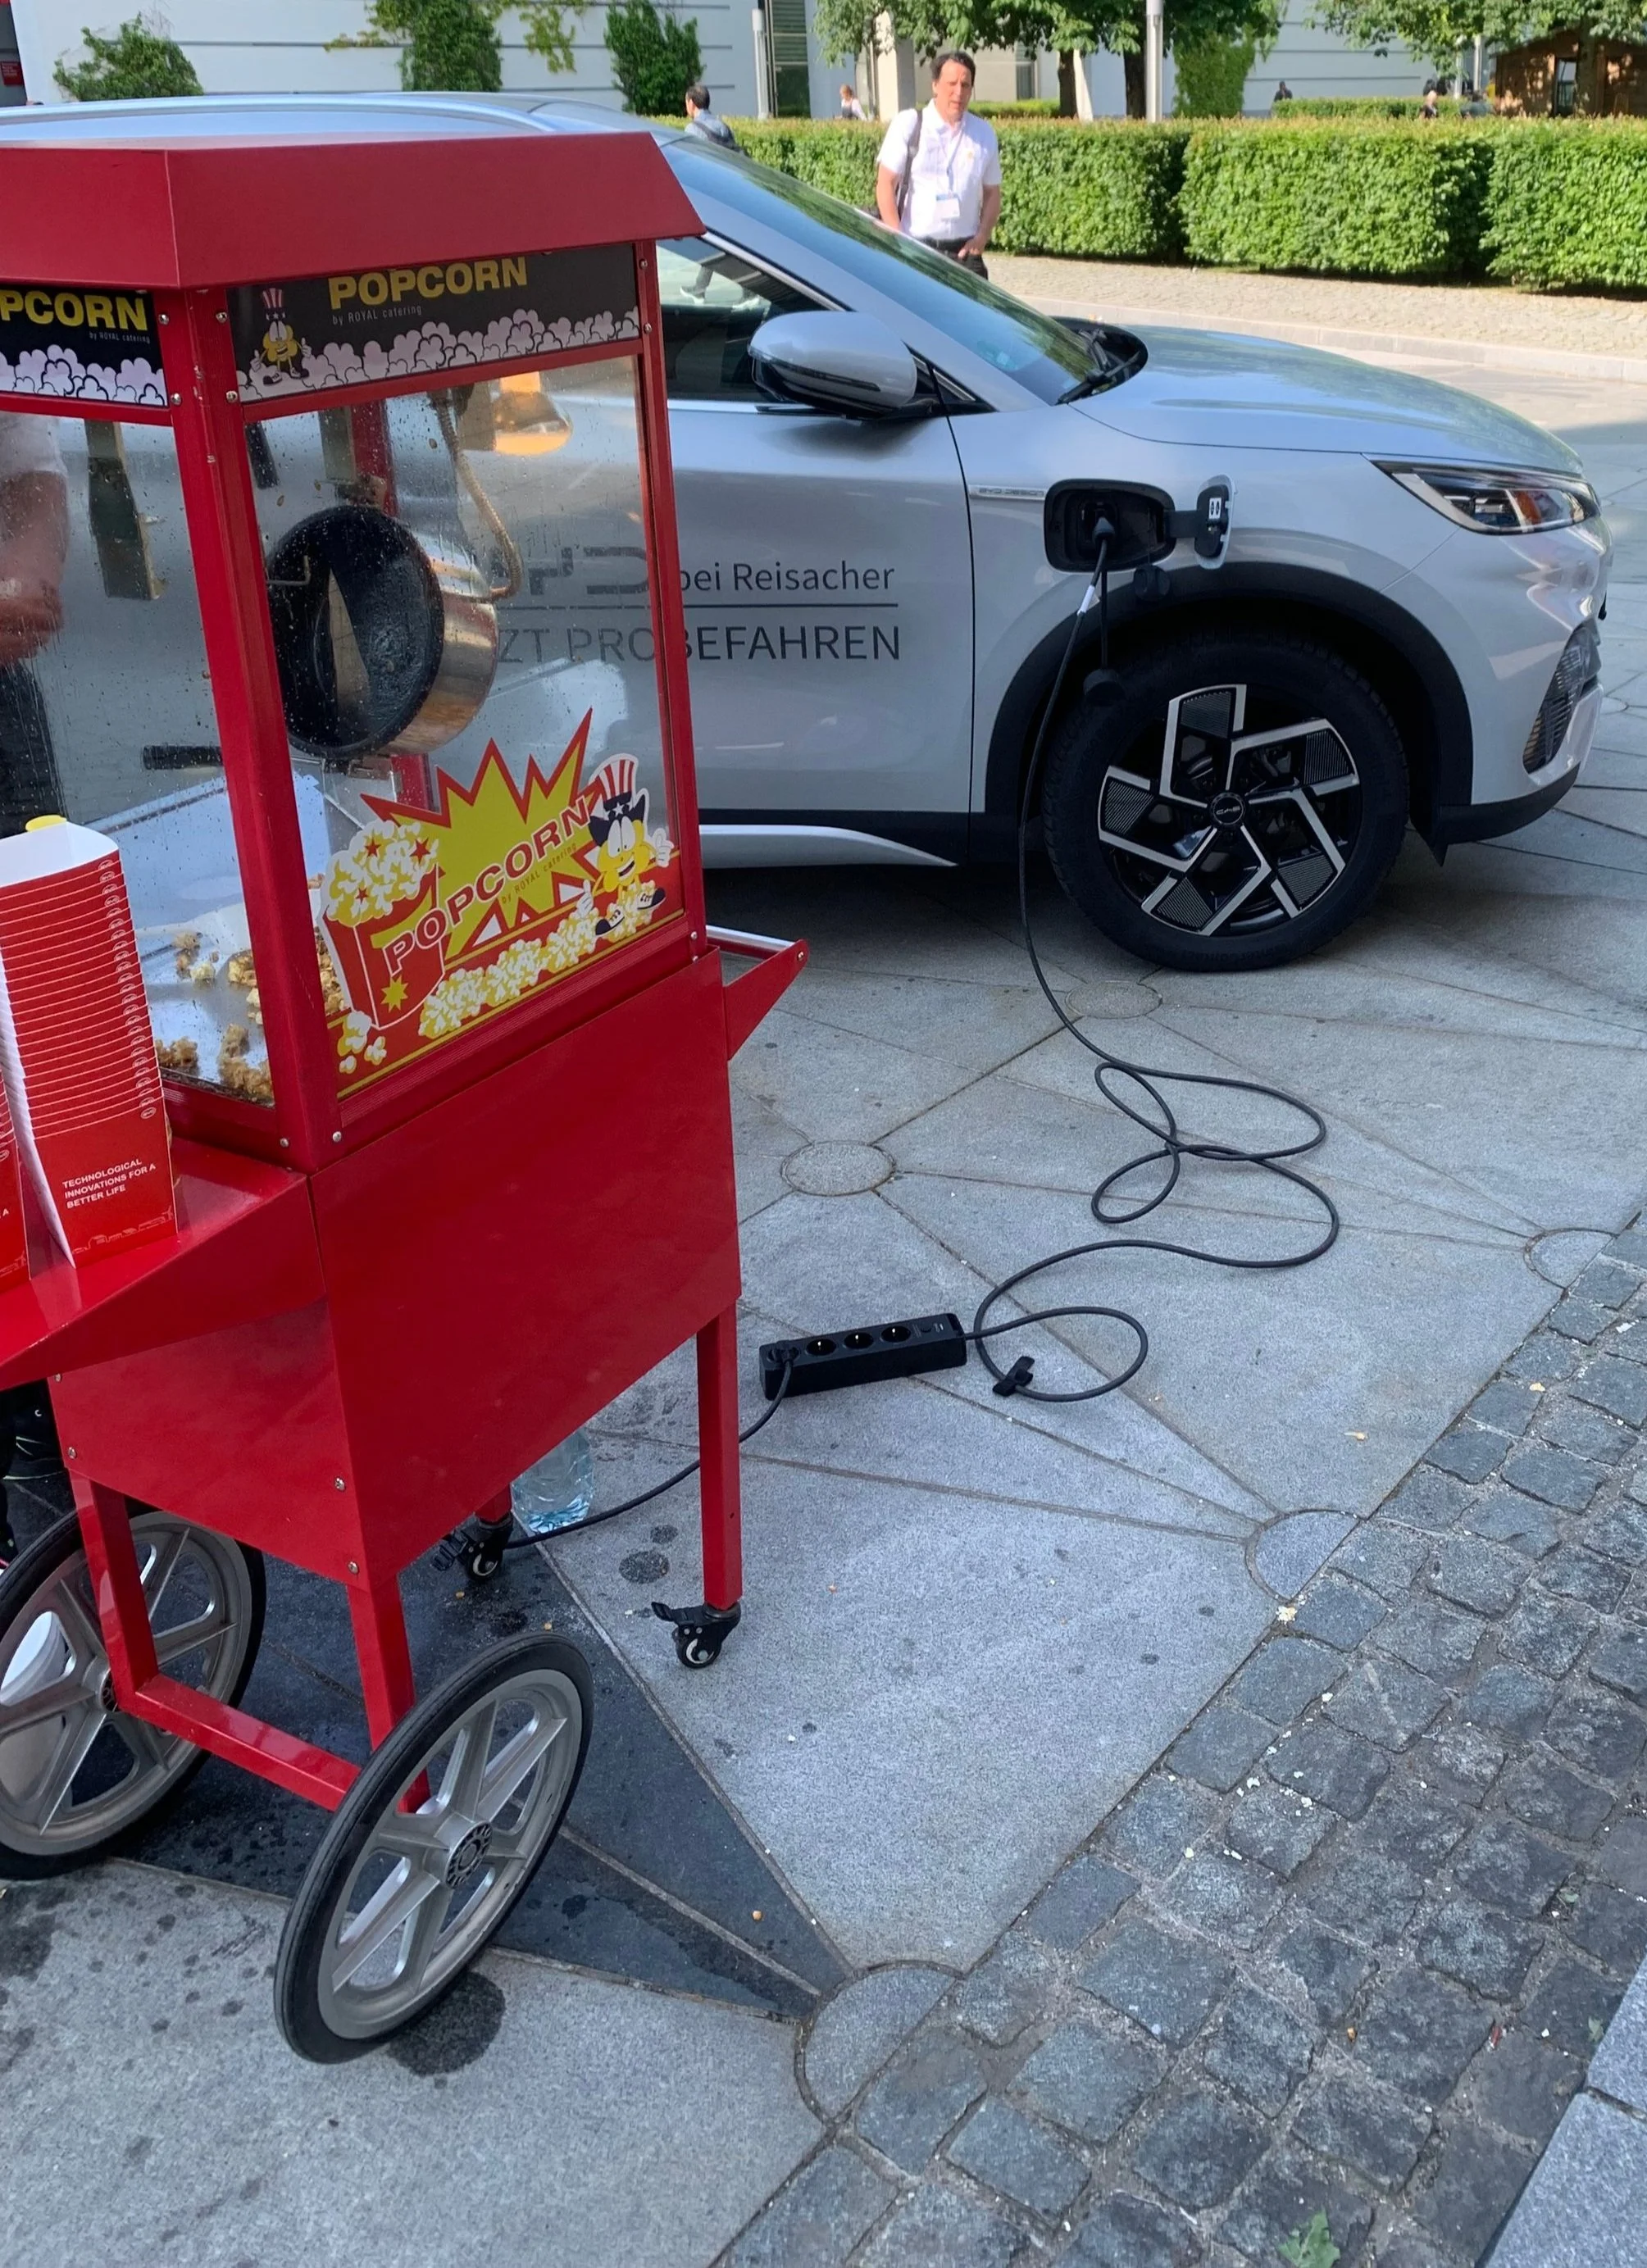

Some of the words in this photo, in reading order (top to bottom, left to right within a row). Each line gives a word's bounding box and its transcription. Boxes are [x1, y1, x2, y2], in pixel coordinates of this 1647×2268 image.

[329, 257, 527, 309] POPCORN
[0, 289, 148, 330] PCORN
[332, 314, 344, 325] by
[348, 310, 378, 323] ROYAL
[382, 306, 422, 318] catering
[99, 331, 120, 341] ROYAL
[122, 334, 150, 343] catering
[733, 561, 895, 591] Reisacher
[514, 871, 541, 894] ROYAL
[543, 843, 577, 872] catering
[382, 794, 593, 978] POPCORN
[62, 1158, 142, 1189] TECHNOLOGICAL
[65, 1174, 126, 1198] INNOVATIONS
[129, 1166, 148, 1179] FOR
[149, 1163, 156, 1171] A
[66, 1191, 104, 1209] BETTER
[106, 1184, 126, 1197] LIFE
